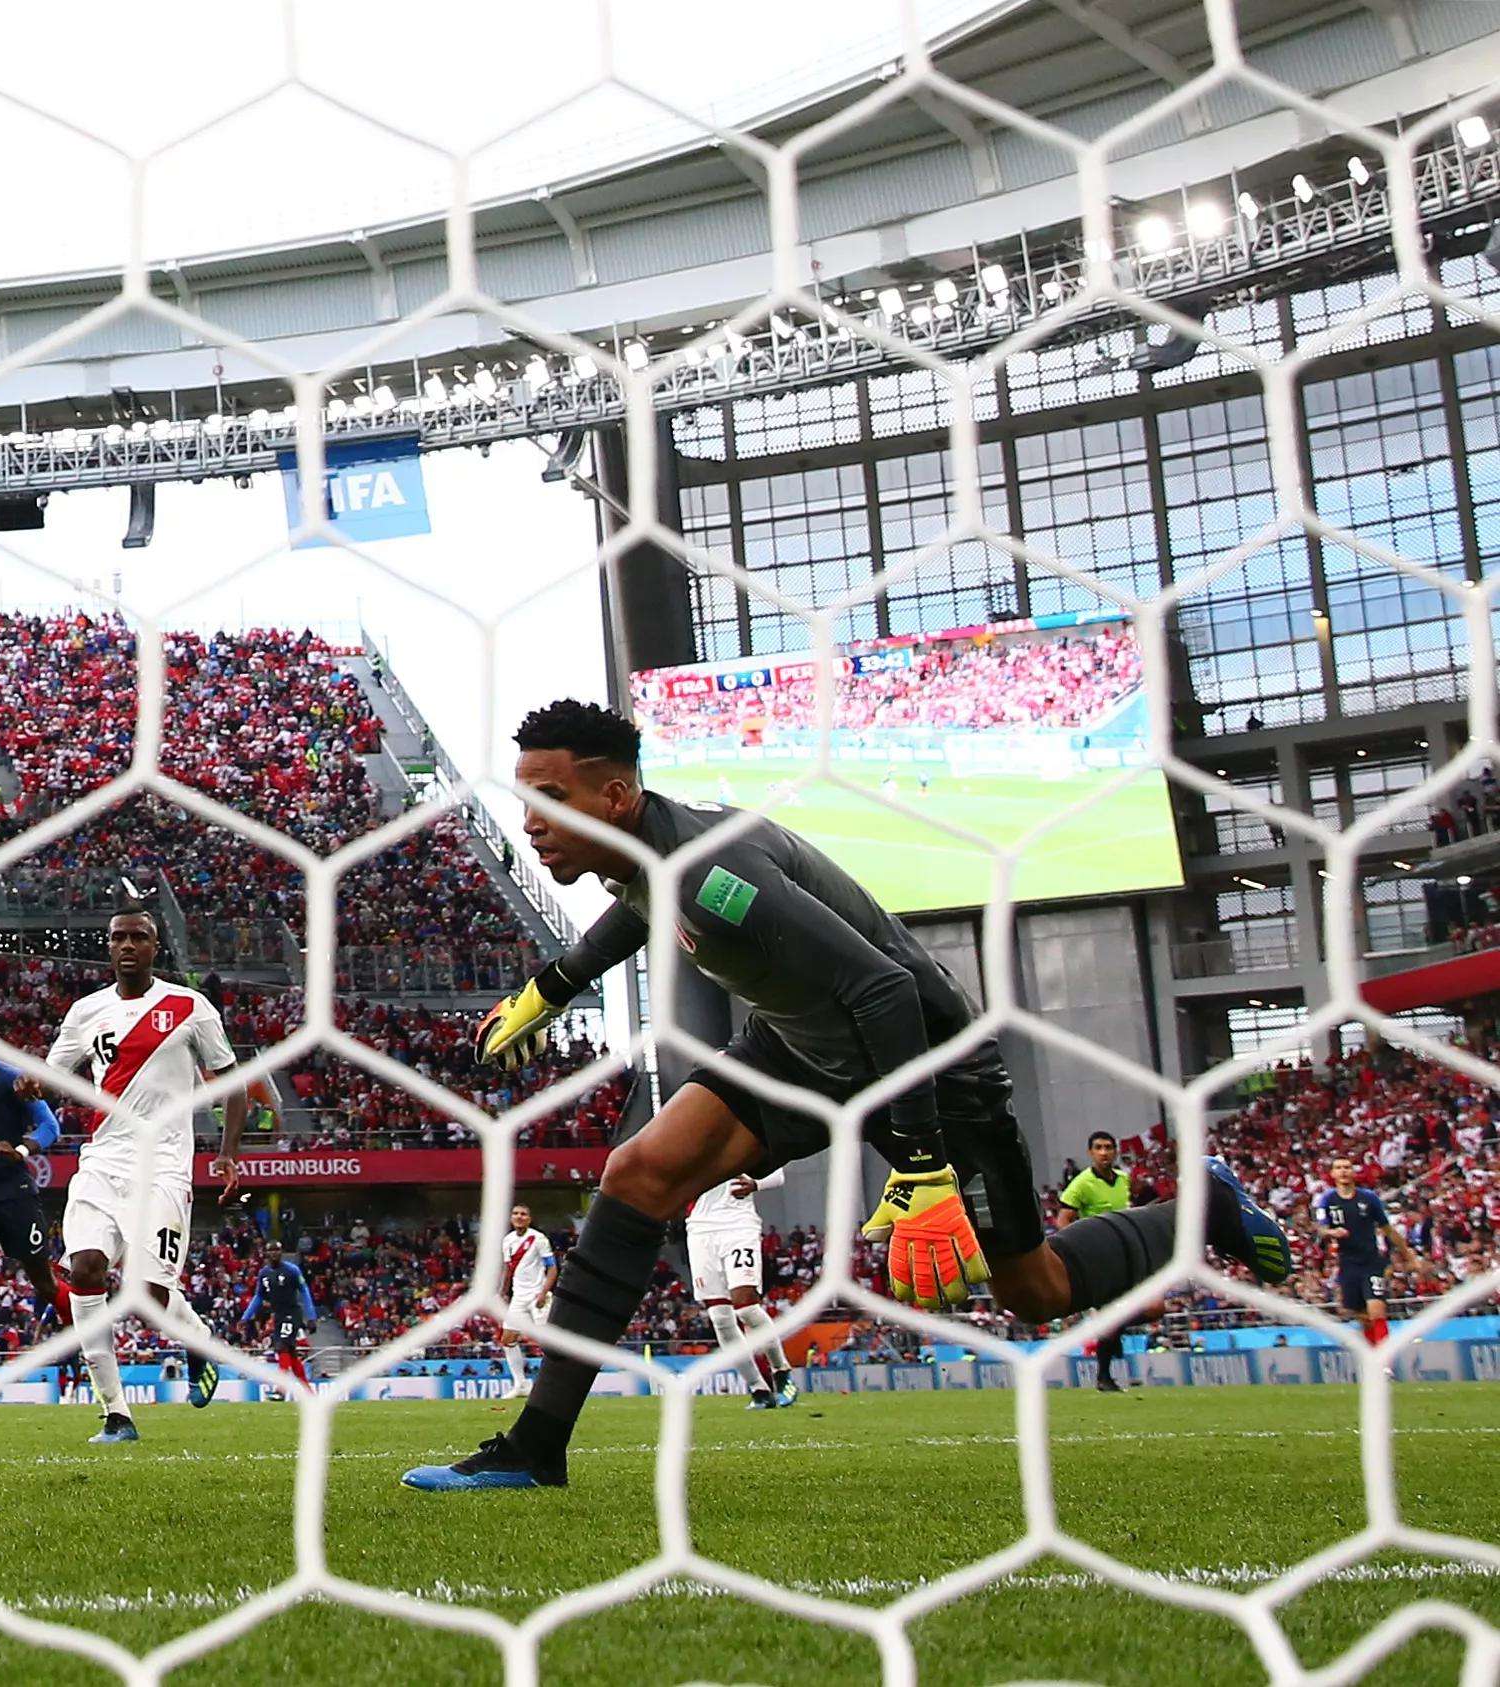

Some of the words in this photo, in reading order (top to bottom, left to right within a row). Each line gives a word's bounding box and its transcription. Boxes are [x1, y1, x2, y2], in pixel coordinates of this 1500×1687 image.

[320, 471, 406, 514] IFA
[673, 679, 708, 694] FRA
[93, 1031, 119, 1065] 15
[208, 1158, 361, 1177] EATERINBURG
[29, 1222, 42, 1246] 6
[157, 1227, 181, 1264] 15
[731, 1248, 754, 1268] 23
